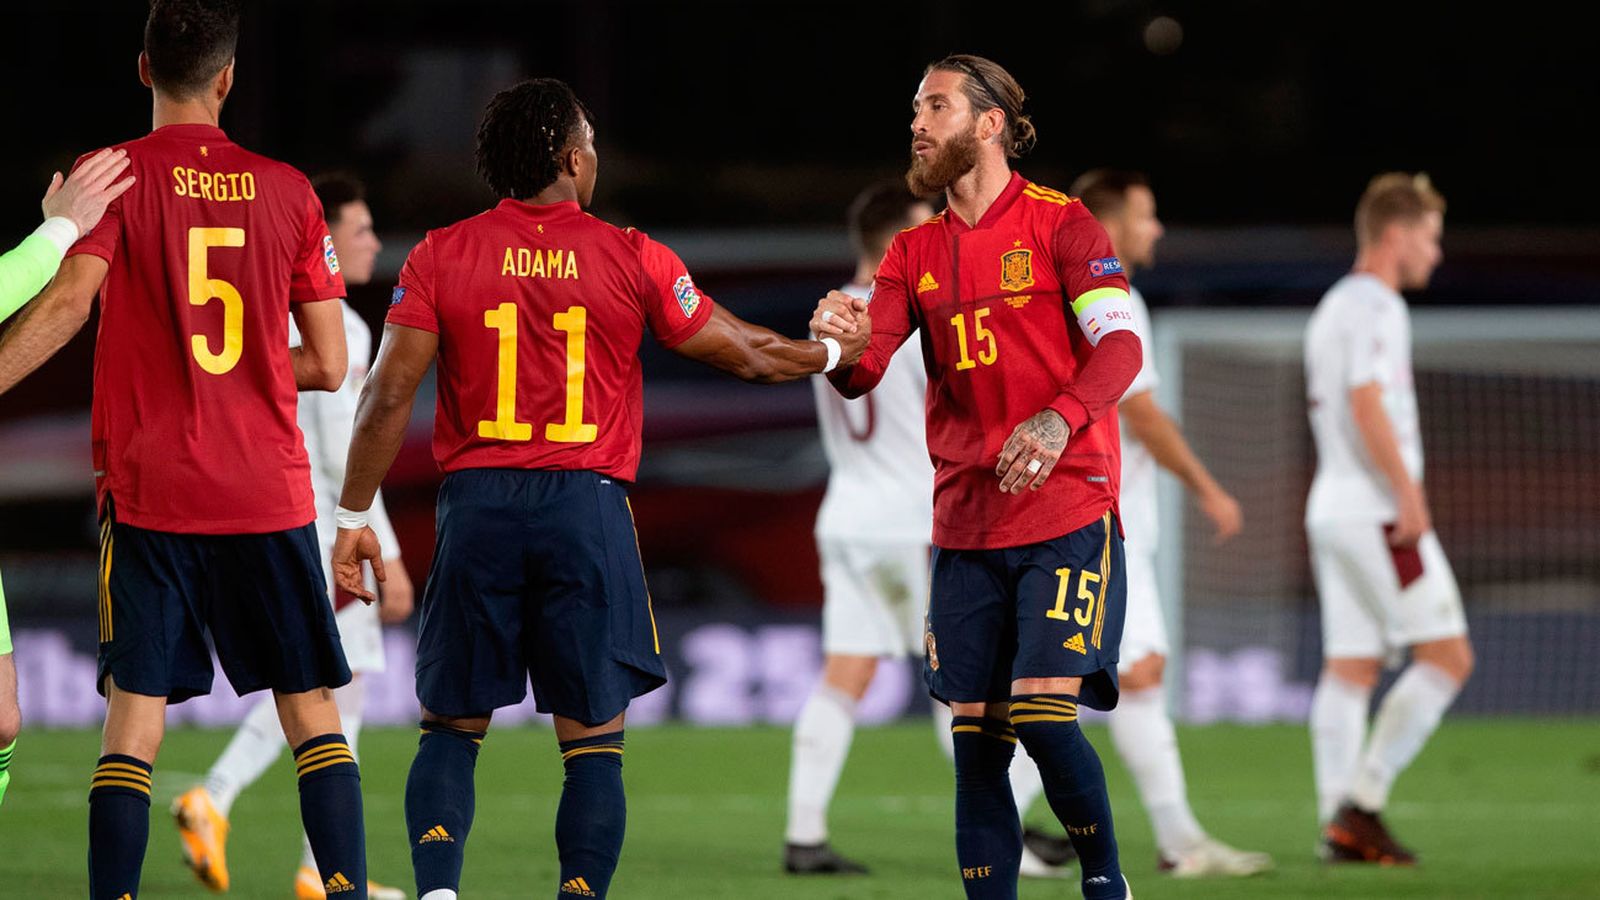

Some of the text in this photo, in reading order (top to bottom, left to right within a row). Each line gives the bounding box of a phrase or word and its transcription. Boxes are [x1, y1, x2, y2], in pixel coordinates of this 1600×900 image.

[173, 166, 256, 202] SERGIO
[502, 247, 579, 280] ADAMA
[188, 227, 246, 375] 5
[951, 307, 998, 371] 15
[477, 302, 599, 443] 11
[1045, 567, 1101, 627] 15
[962, 866, 992, 880] RFEF
